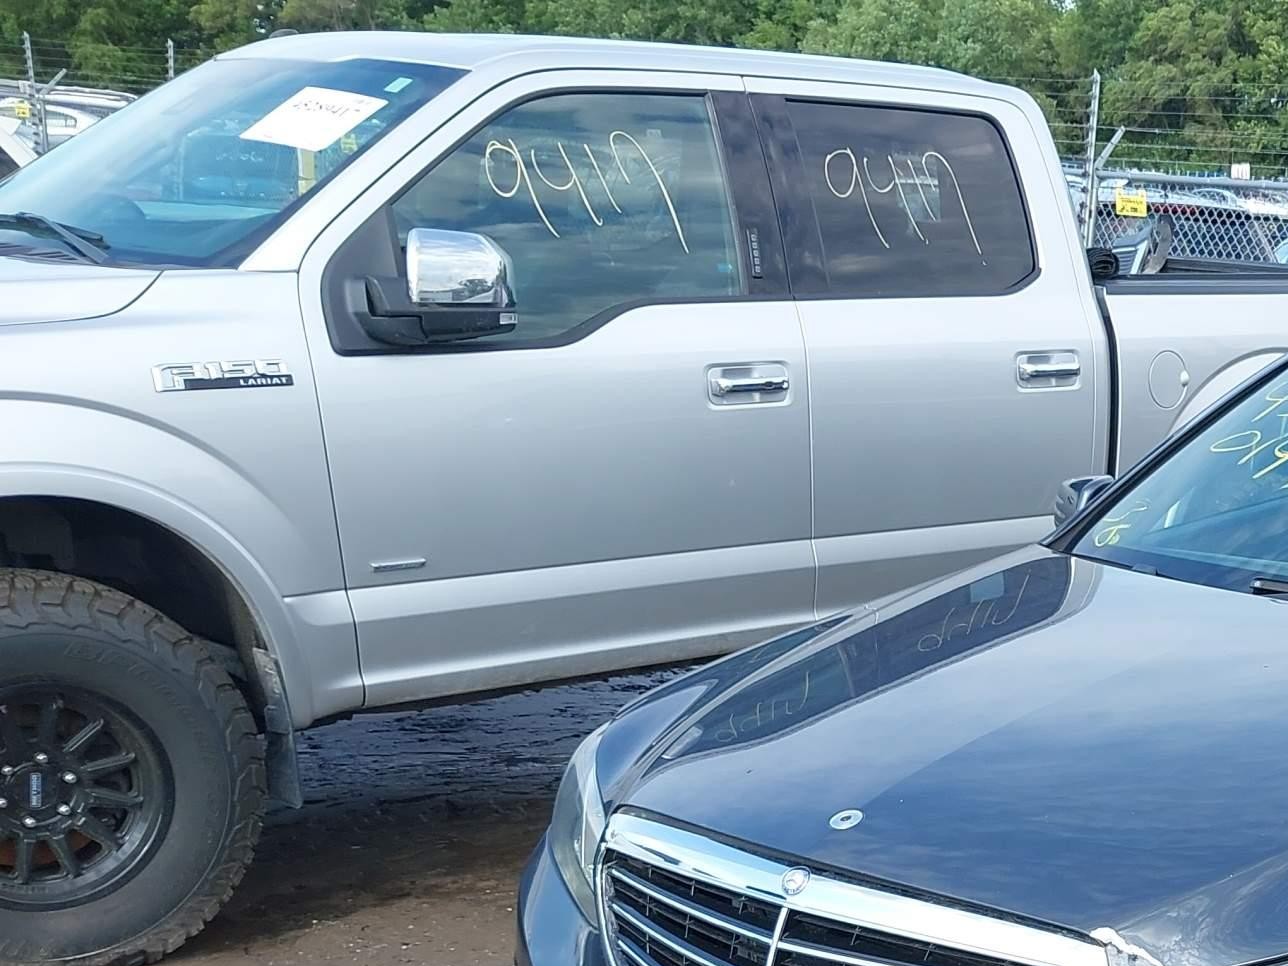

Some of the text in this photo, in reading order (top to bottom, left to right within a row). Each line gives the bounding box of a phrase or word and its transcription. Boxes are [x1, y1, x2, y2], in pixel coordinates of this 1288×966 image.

[485, 130, 690, 254] 9417
[824, 147, 983, 256] 9417
[239, 376, 289, 386] LARIAT
